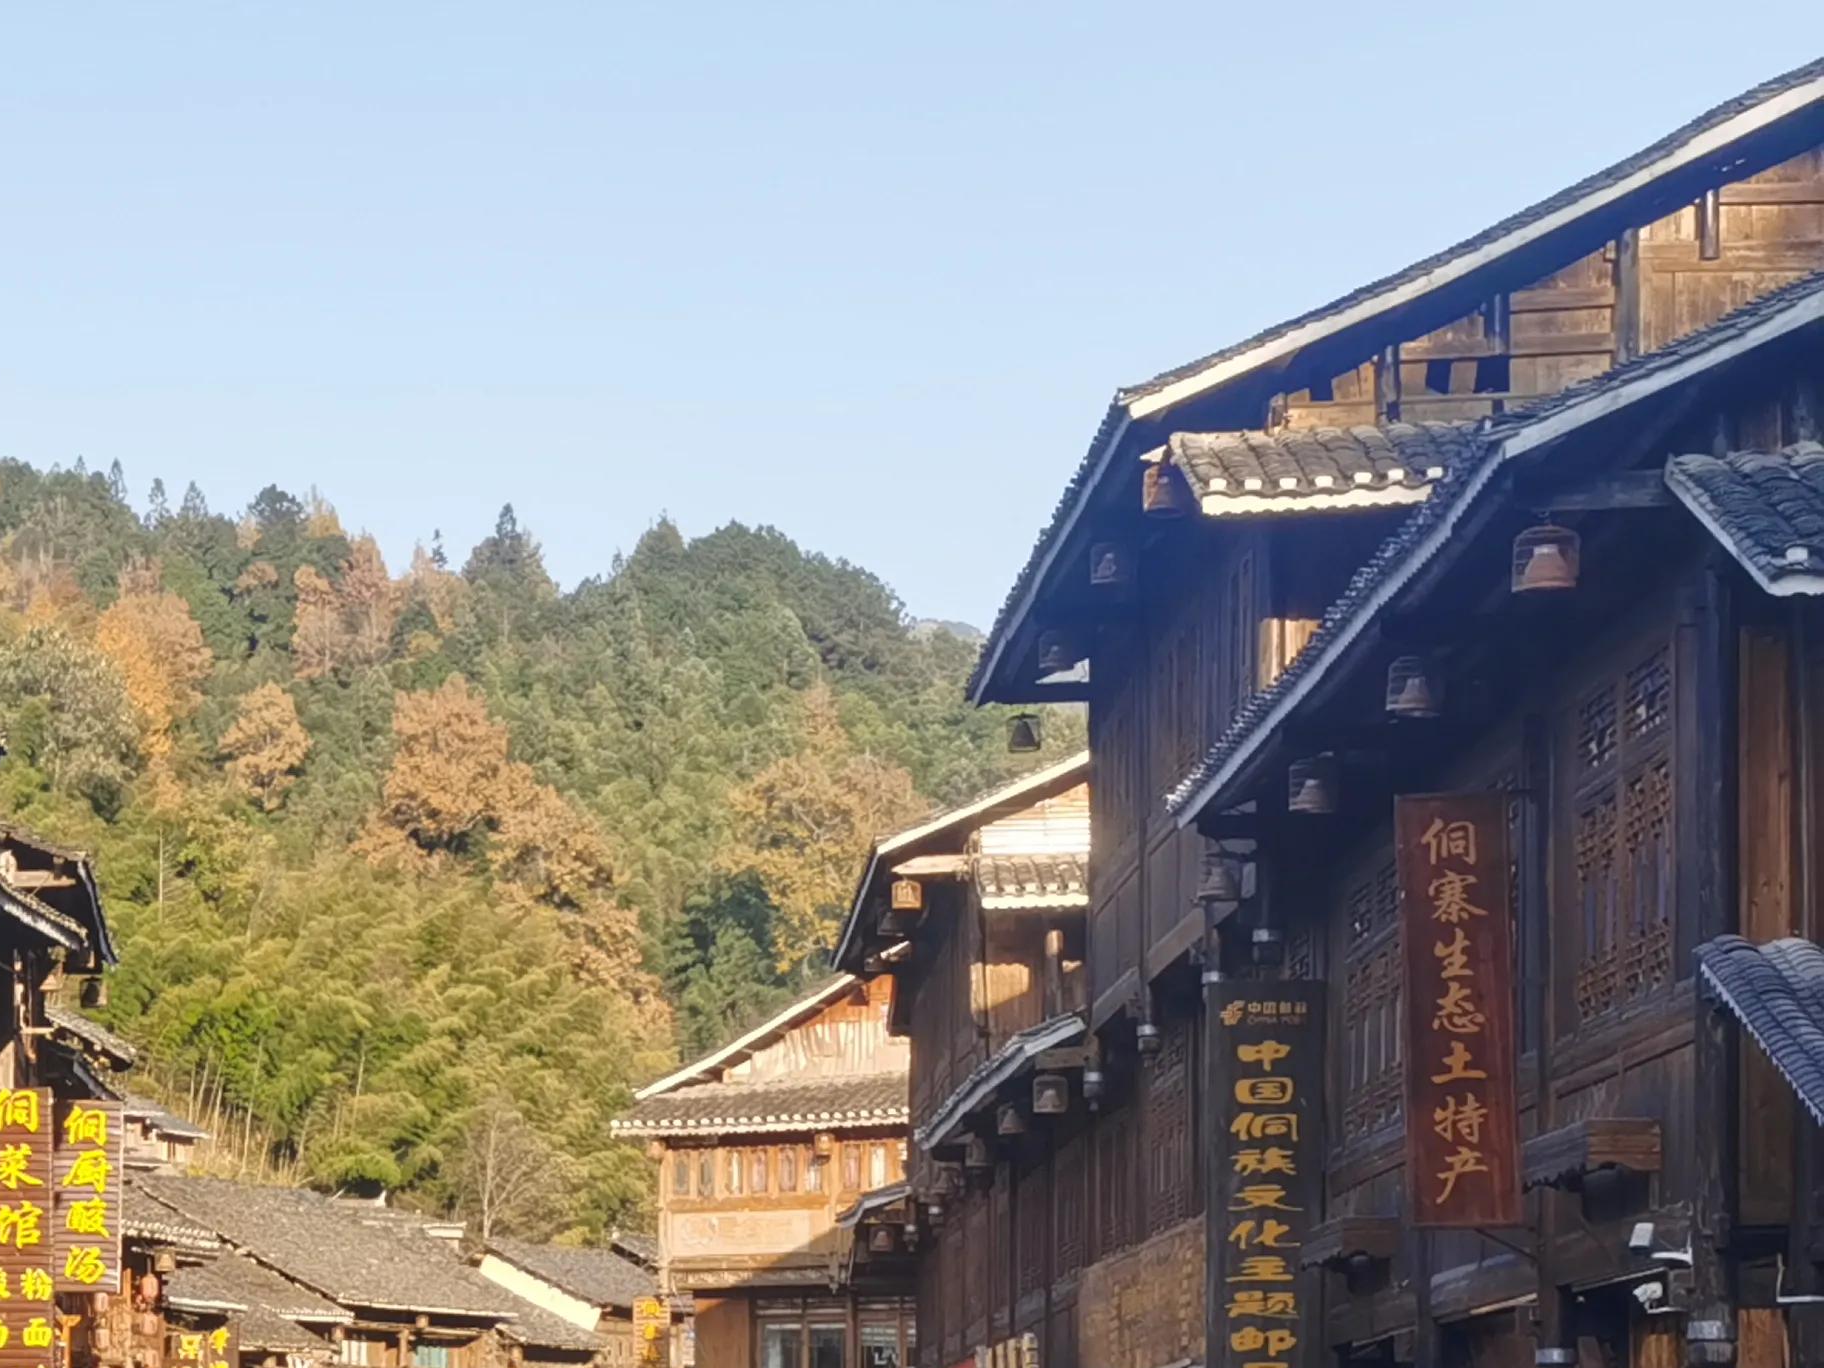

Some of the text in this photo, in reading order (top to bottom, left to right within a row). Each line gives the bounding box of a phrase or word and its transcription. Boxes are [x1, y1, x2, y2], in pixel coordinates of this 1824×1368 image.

[1421, 816, 1491, 1206] 侗寨生态土特产
[62, 1104, 113, 1285] 侗厨酸汤
